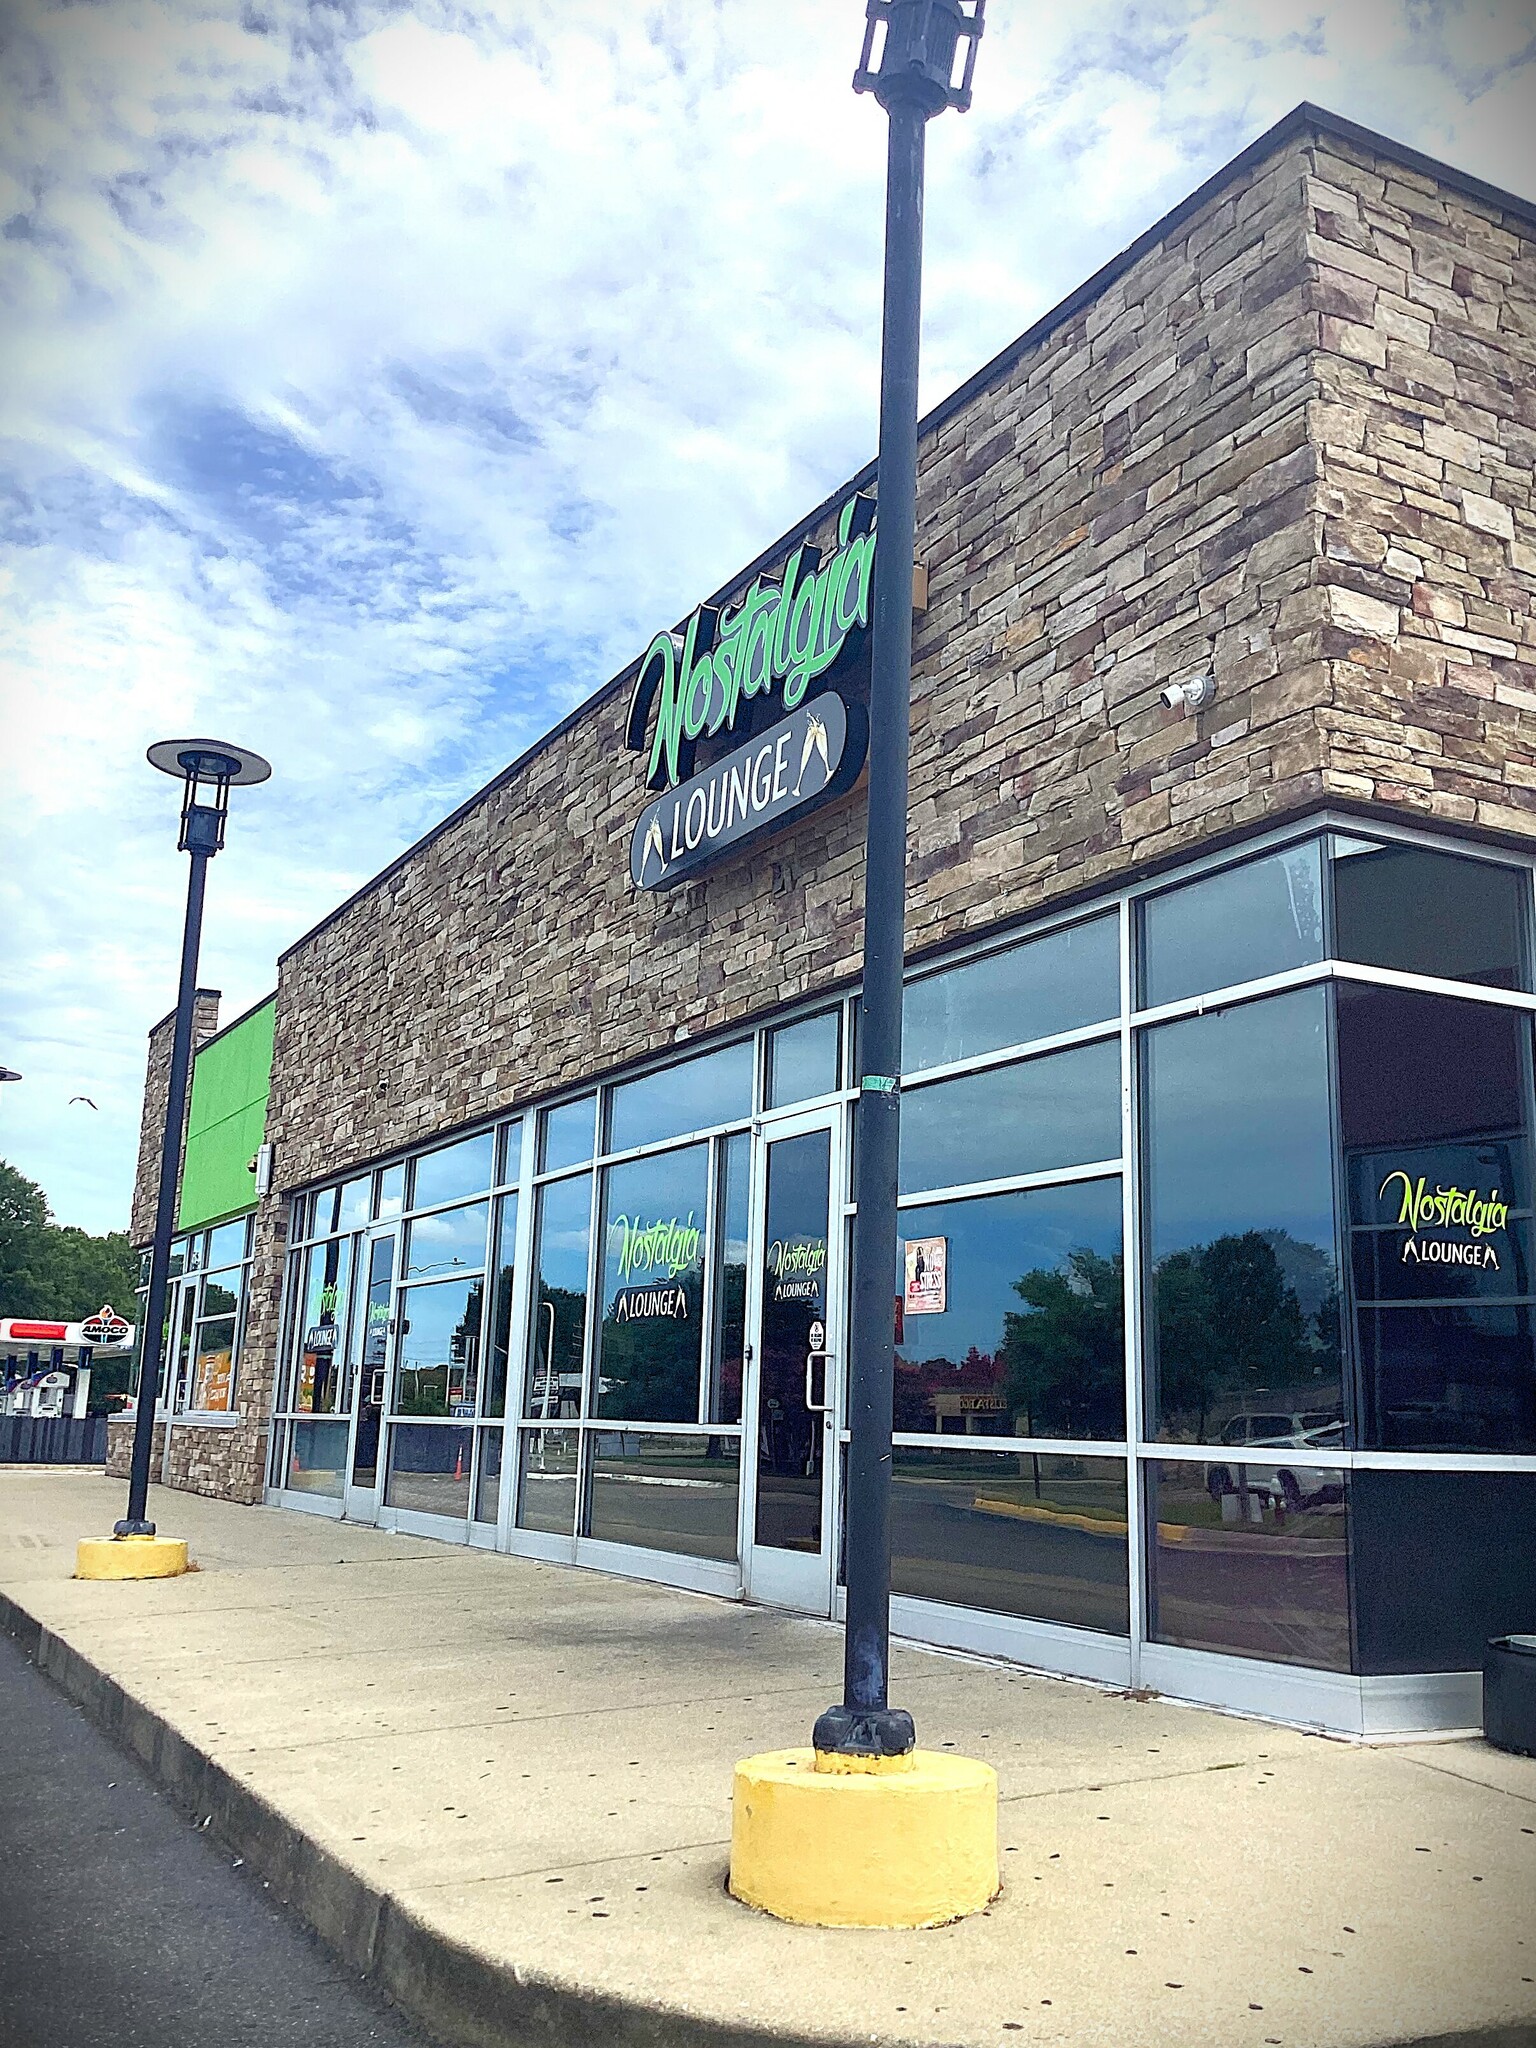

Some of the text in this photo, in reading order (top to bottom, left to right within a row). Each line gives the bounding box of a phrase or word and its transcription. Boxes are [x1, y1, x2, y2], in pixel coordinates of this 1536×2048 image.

[625, 492, 877, 789] Nostalgia
[671, 731, 792, 859] LOUNGE
[1379, 1171, 1508, 1237] Nostalgia
[607, 1210, 700, 1284] Nostalgia
[768, 1240, 826, 1280] Nostalgia
[1422, 1240, 1482, 1265] LOUNGE
[630, 1289, 676, 1318] LOUNGE
[783, 1281, 811, 1298] LOUNGE
[82, 1326, 129, 1334] AMOCO
